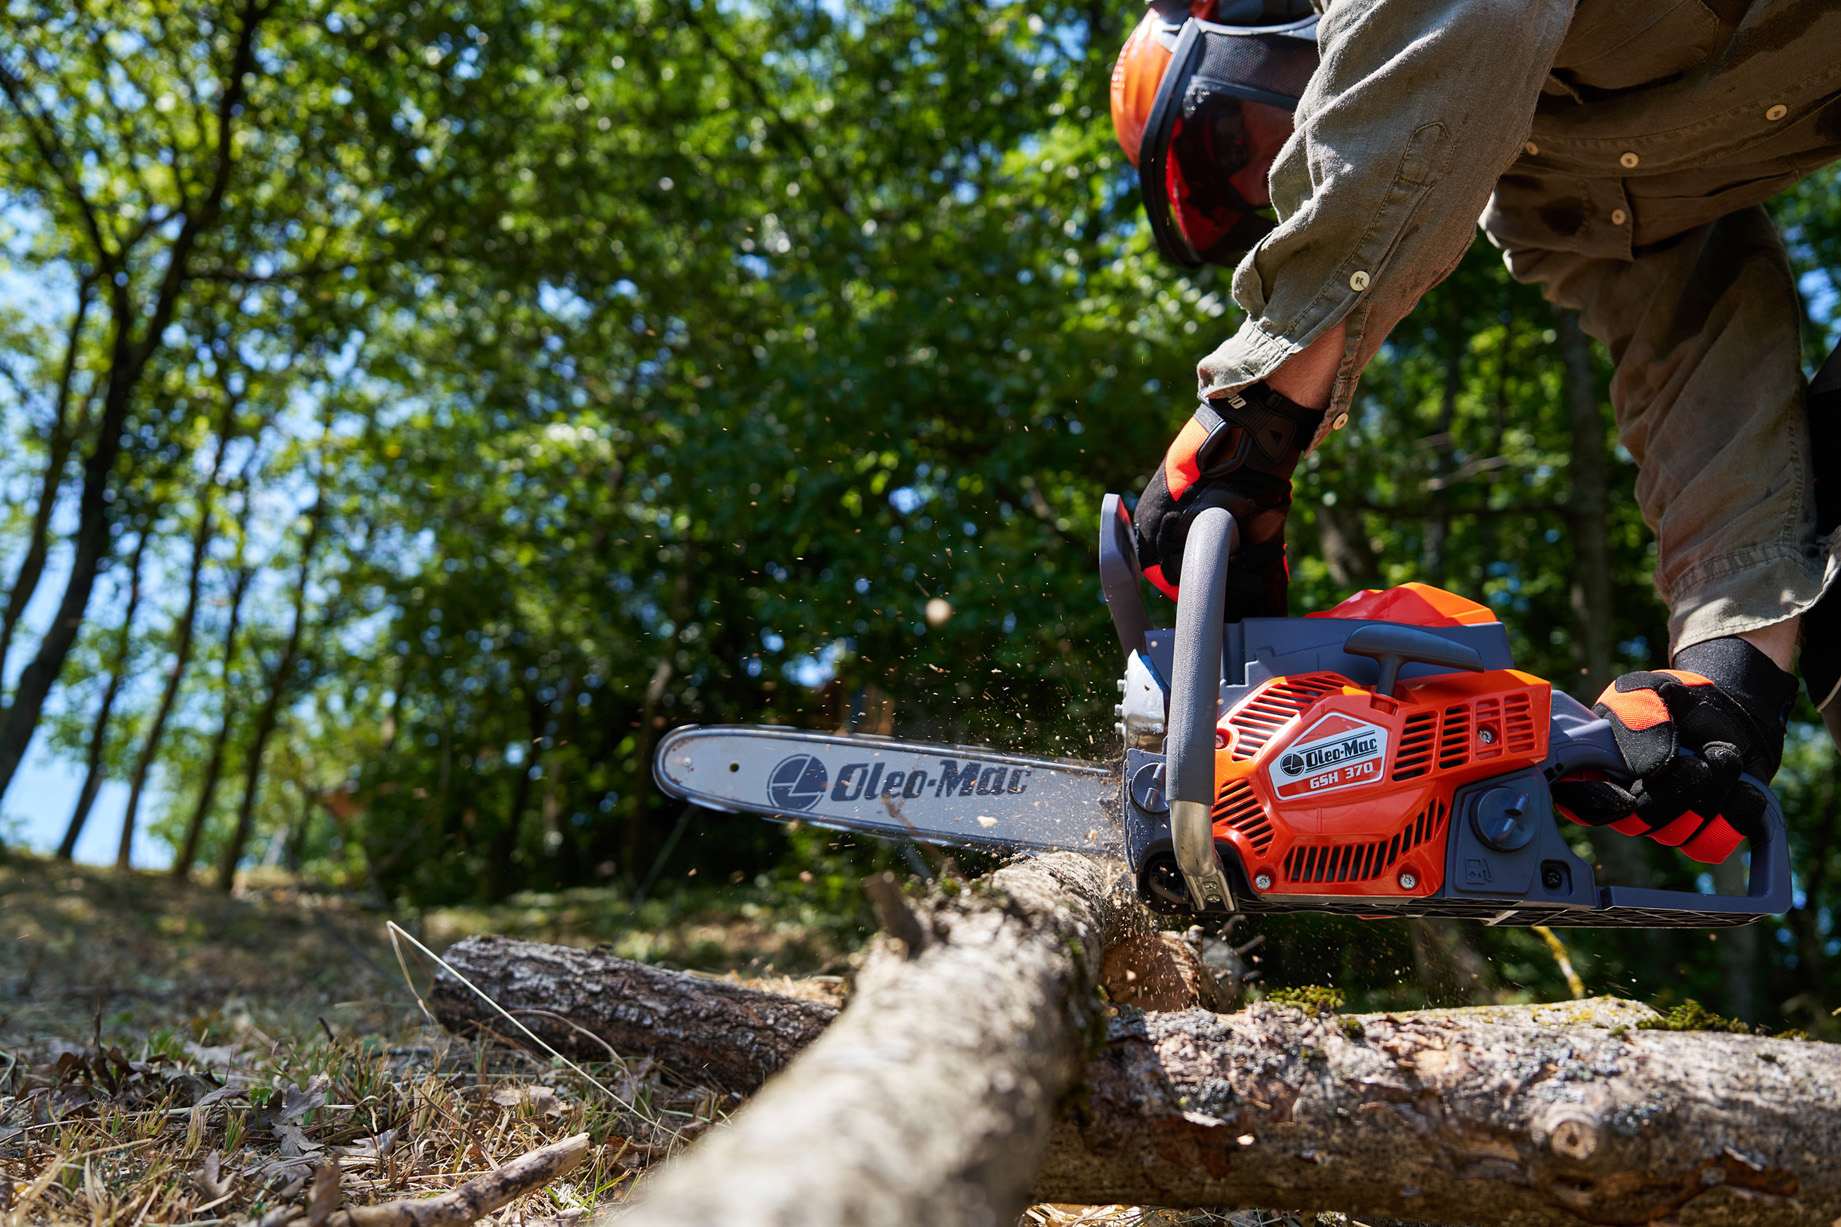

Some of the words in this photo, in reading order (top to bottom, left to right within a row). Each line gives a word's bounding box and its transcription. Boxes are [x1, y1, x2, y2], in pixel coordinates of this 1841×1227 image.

[1305, 738, 1377, 768] Oleo-Mac
[830, 759, 1031, 801] Oleo-Mac
[1309, 771, 1338, 789] GSH
[1345, 762, 1373, 780] 370
